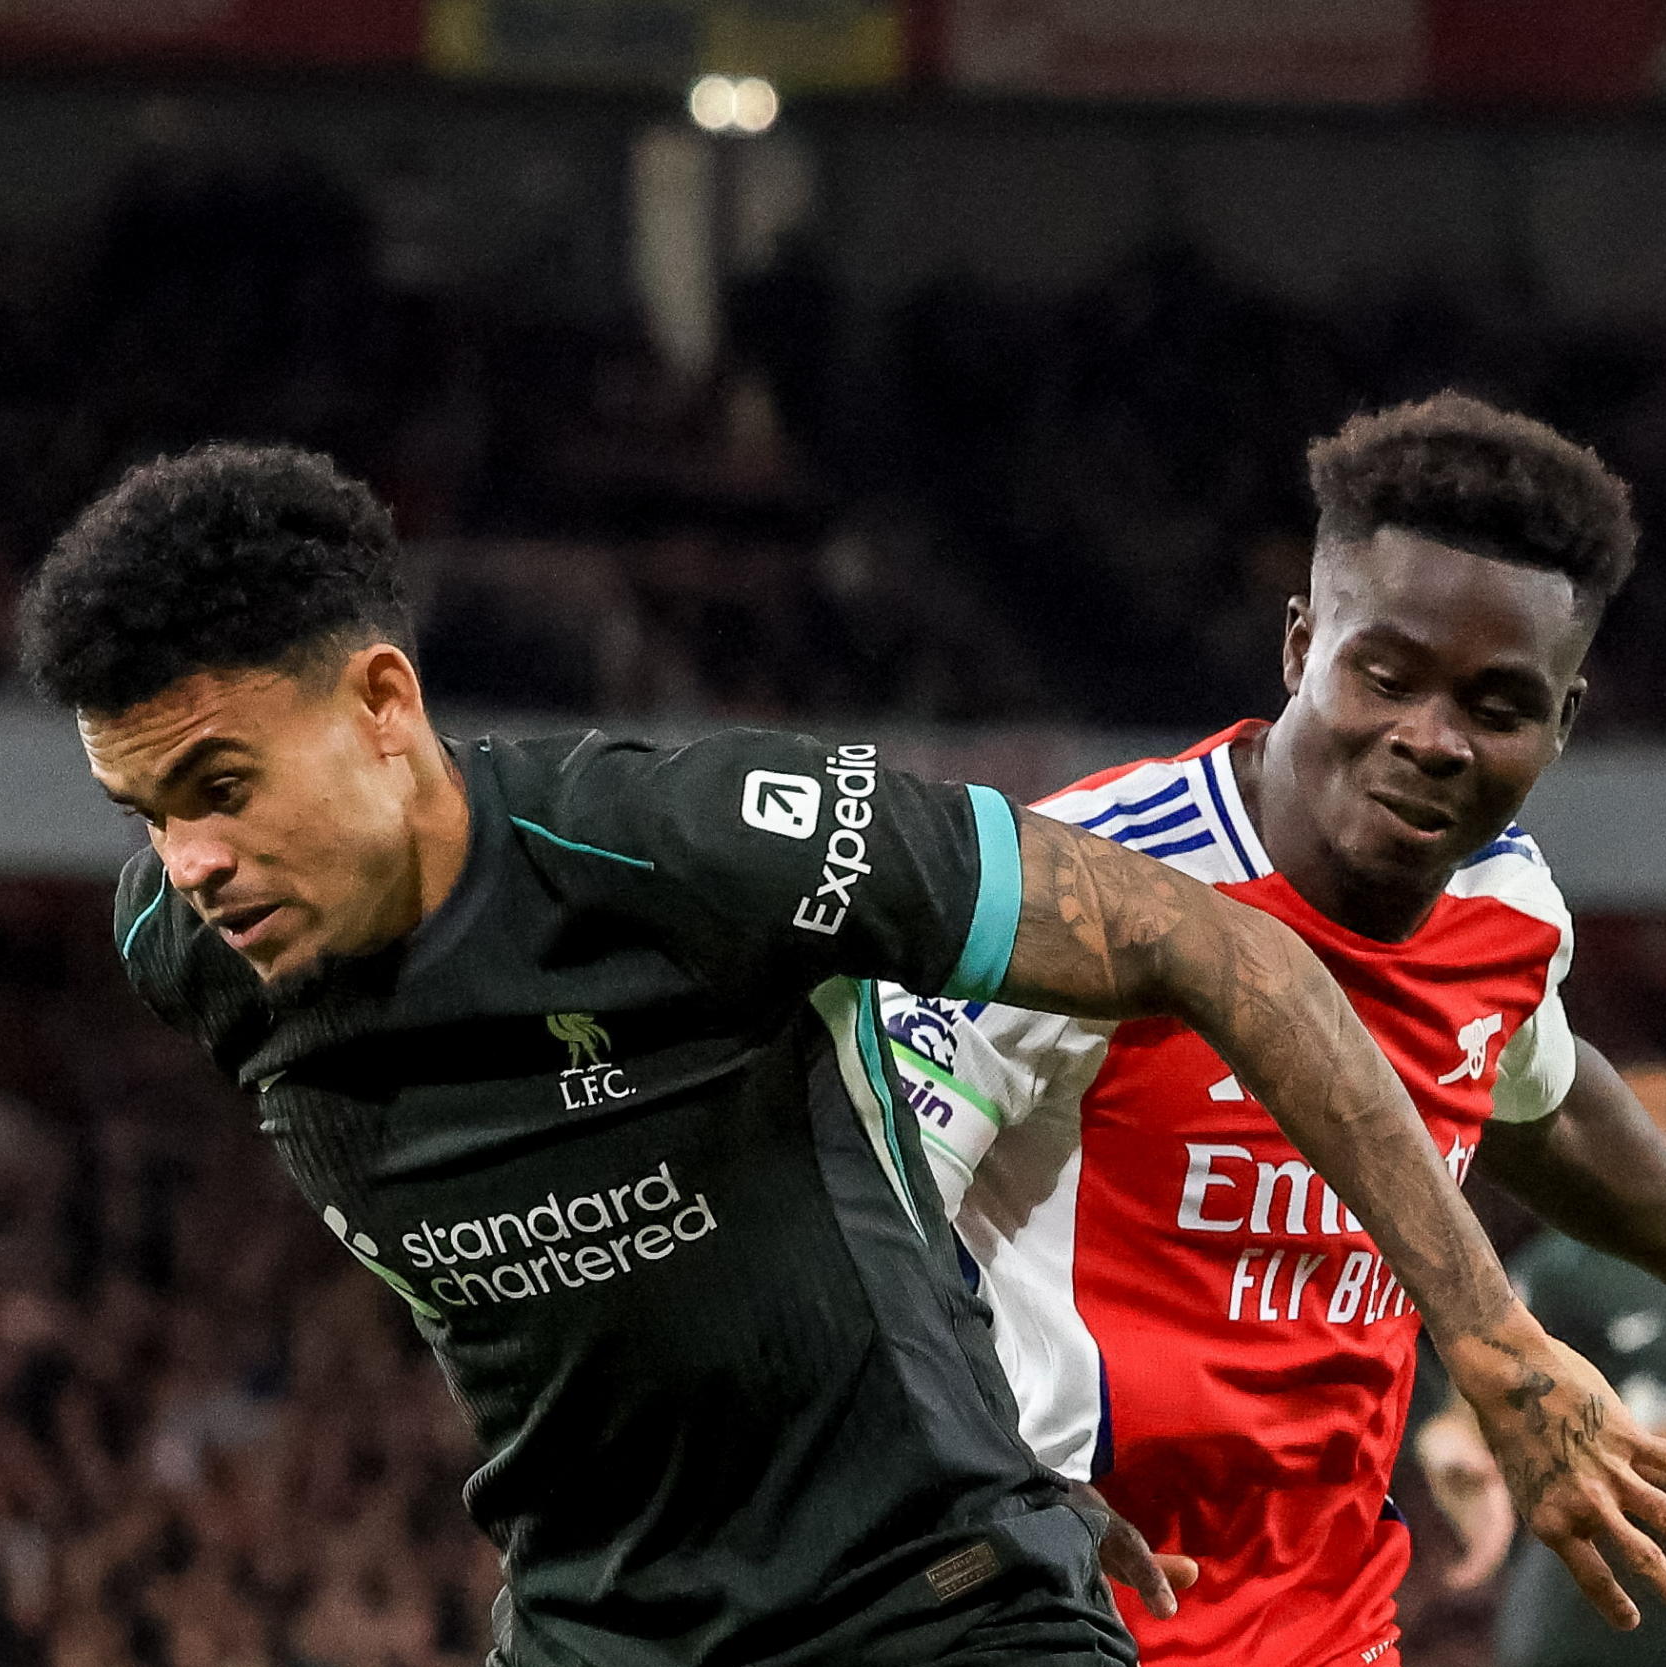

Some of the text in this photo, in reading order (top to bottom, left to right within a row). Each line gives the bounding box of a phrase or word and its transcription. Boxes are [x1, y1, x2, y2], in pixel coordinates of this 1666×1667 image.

[792, 744, 877, 935] Expedia
[402, 1161, 681, 1268] standard
[431, 1193, 718, 1306] chartered
[1229, 1248, 1327, 1321] FLY
